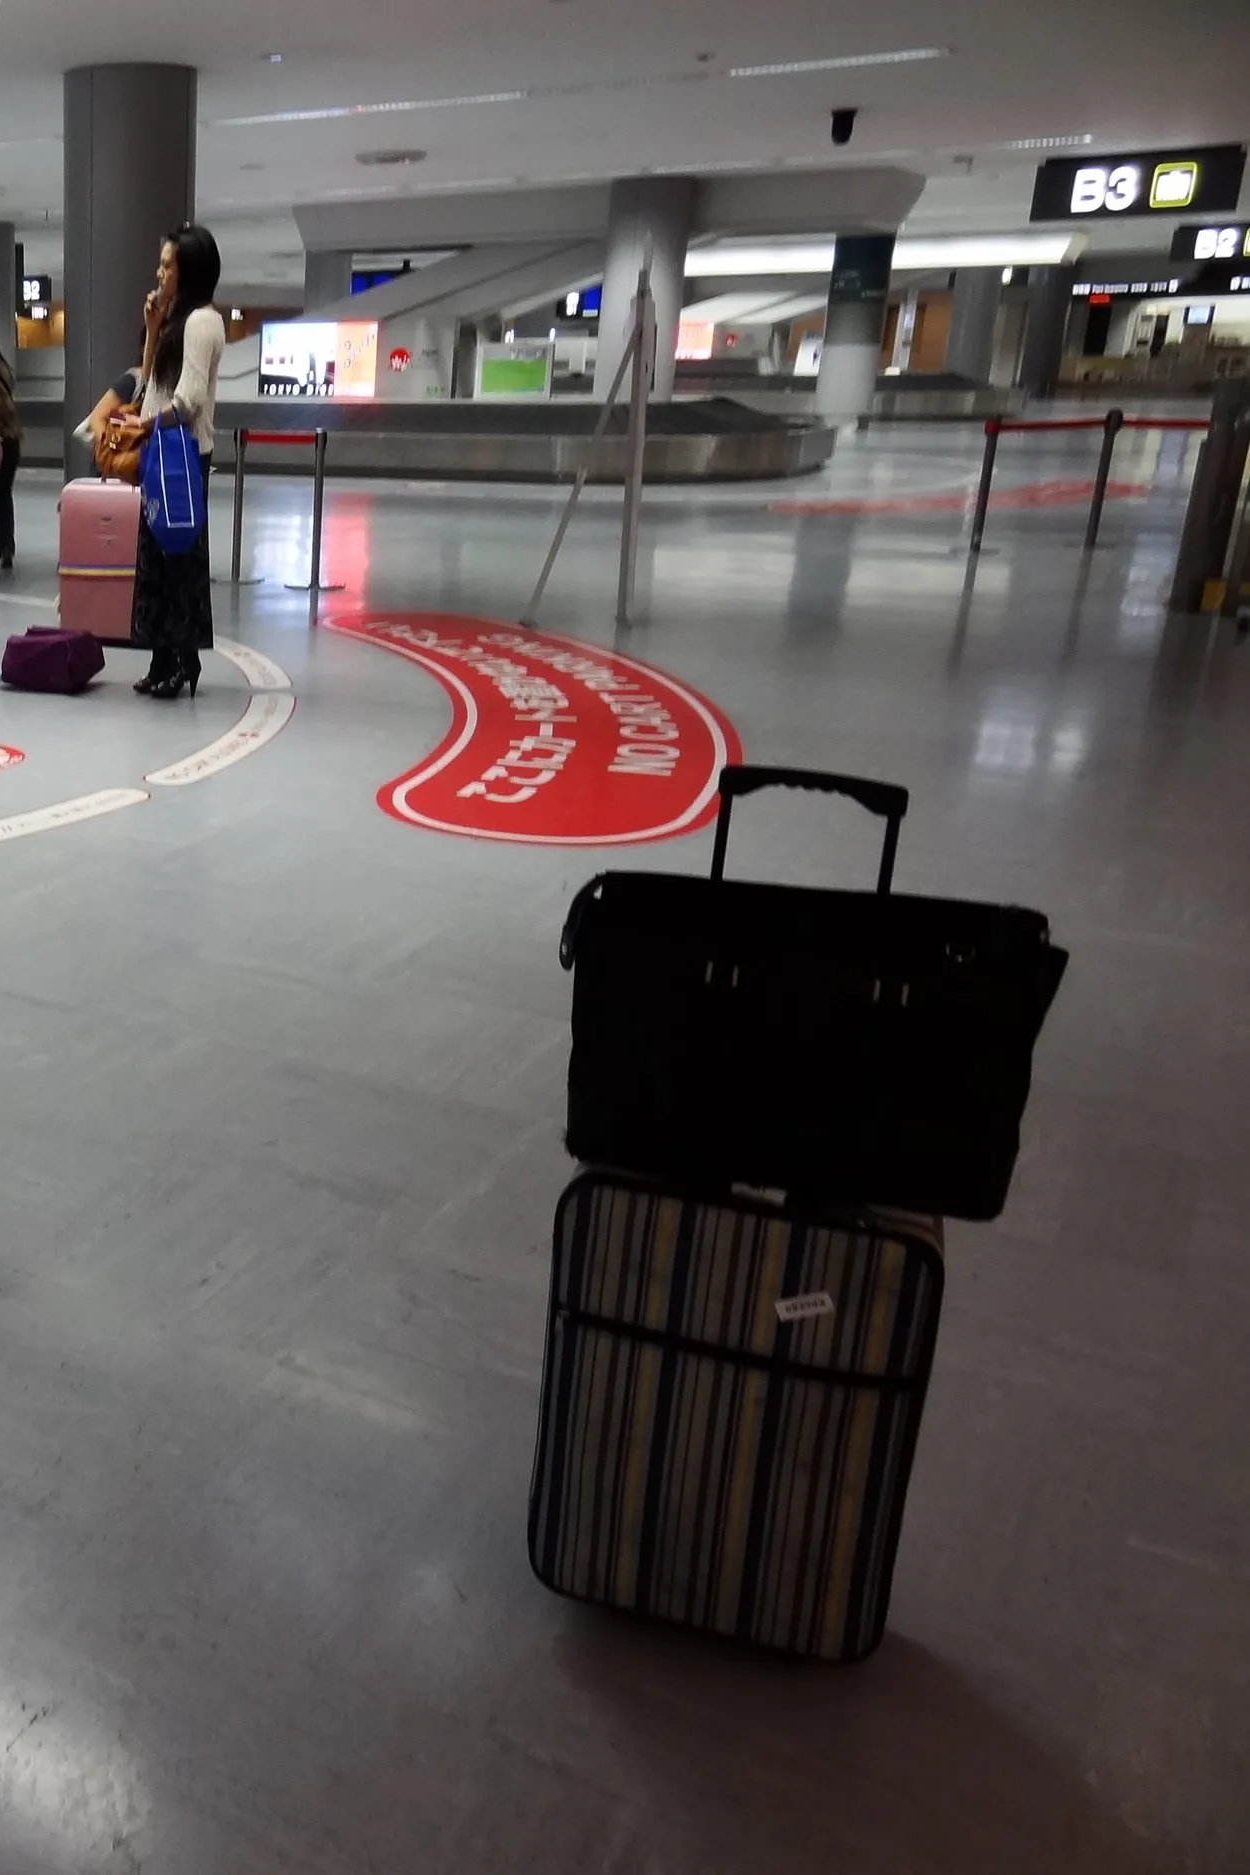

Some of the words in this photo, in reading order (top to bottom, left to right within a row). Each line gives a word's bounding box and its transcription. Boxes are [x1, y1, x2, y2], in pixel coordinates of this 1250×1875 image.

[1071, 166, 1138, 213] B3
[1194, 228, 1238, 260] B2
[598, 694, 681, 741] CART
[607, 743, 681, 777] NO
